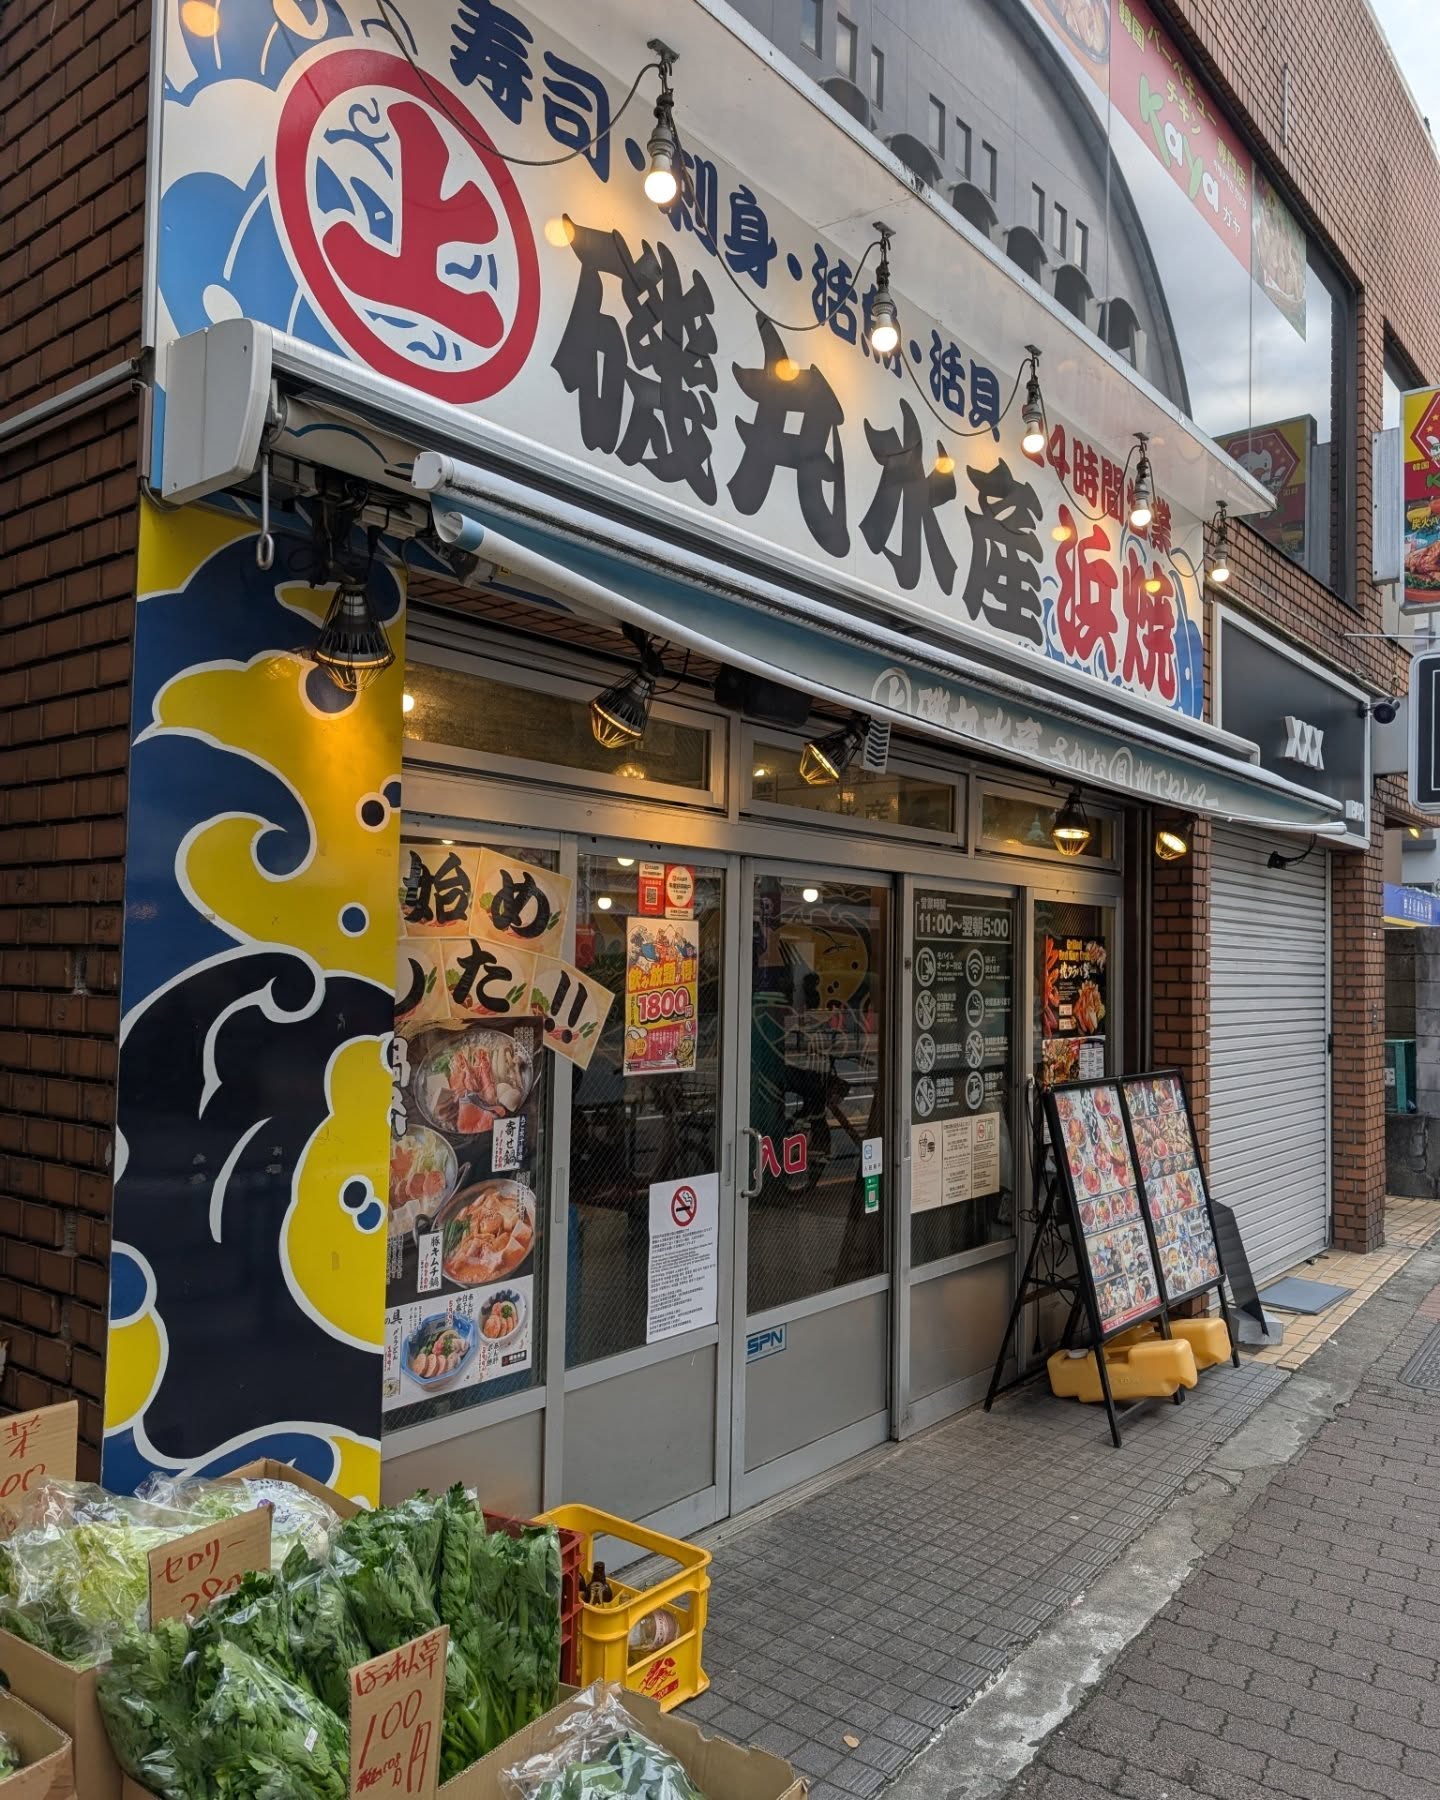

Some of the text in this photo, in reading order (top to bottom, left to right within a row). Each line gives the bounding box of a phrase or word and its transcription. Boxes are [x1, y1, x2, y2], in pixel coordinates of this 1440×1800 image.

[1166, 79, 1201, 135] チキン
[1139, 72, 1219, 214] Kaya
[552, 213, 1043, 646] 磯丸水産
[1054, 504, 1176, 700] 浜焼
[920, 897, 946, 911] 営業時間
[637, 986, 693, 1023] 1800円
[428, 1236, 441, 1289] 豚キムチ鍋
[747, 1328, 783, 1355] SPN
[157, 1538, 246, 1584] セロリー
[355, 1633, 441, 1697] ほうれん草
[358, 1689, 432, 1794] 100円
